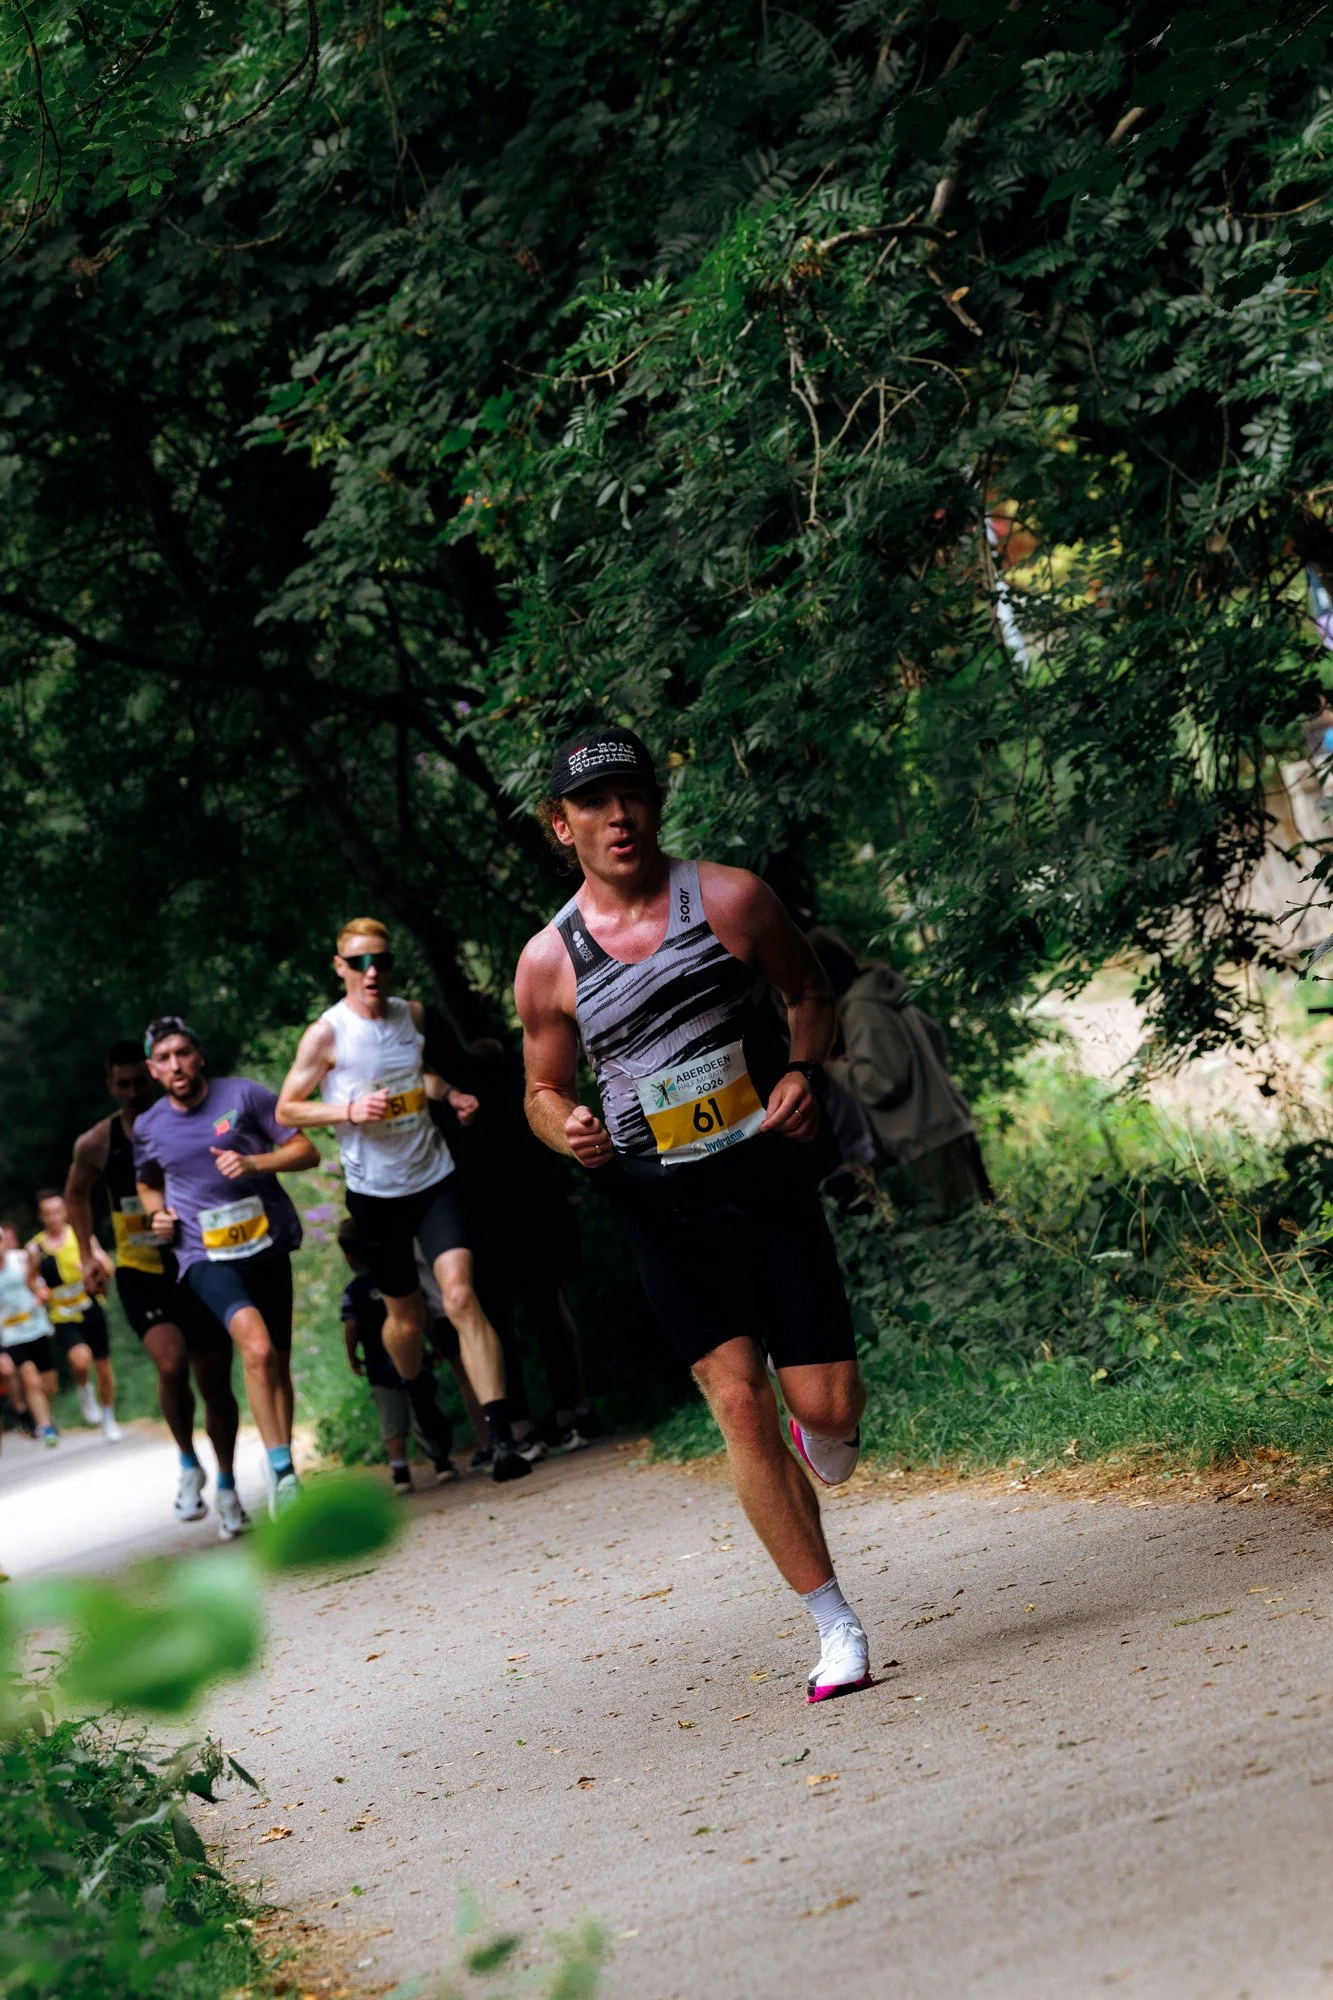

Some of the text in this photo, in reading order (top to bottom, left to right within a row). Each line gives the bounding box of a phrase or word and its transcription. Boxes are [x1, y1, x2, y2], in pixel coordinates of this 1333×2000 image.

[569, 753, 637, 775] EQUIPMENT
[680, 888, 691, 923] soar
[676, 1054, 731, 1084] ABERDEEN
[677, 1063, 733, 1091] HALF MARATHON
[696, 1079, 724, 1094] 2026
[693, 1098, 724, 1133] 61
[704, 1129, 745, 1153] hydrasun
[229, 1225, 246, 1244] 91
